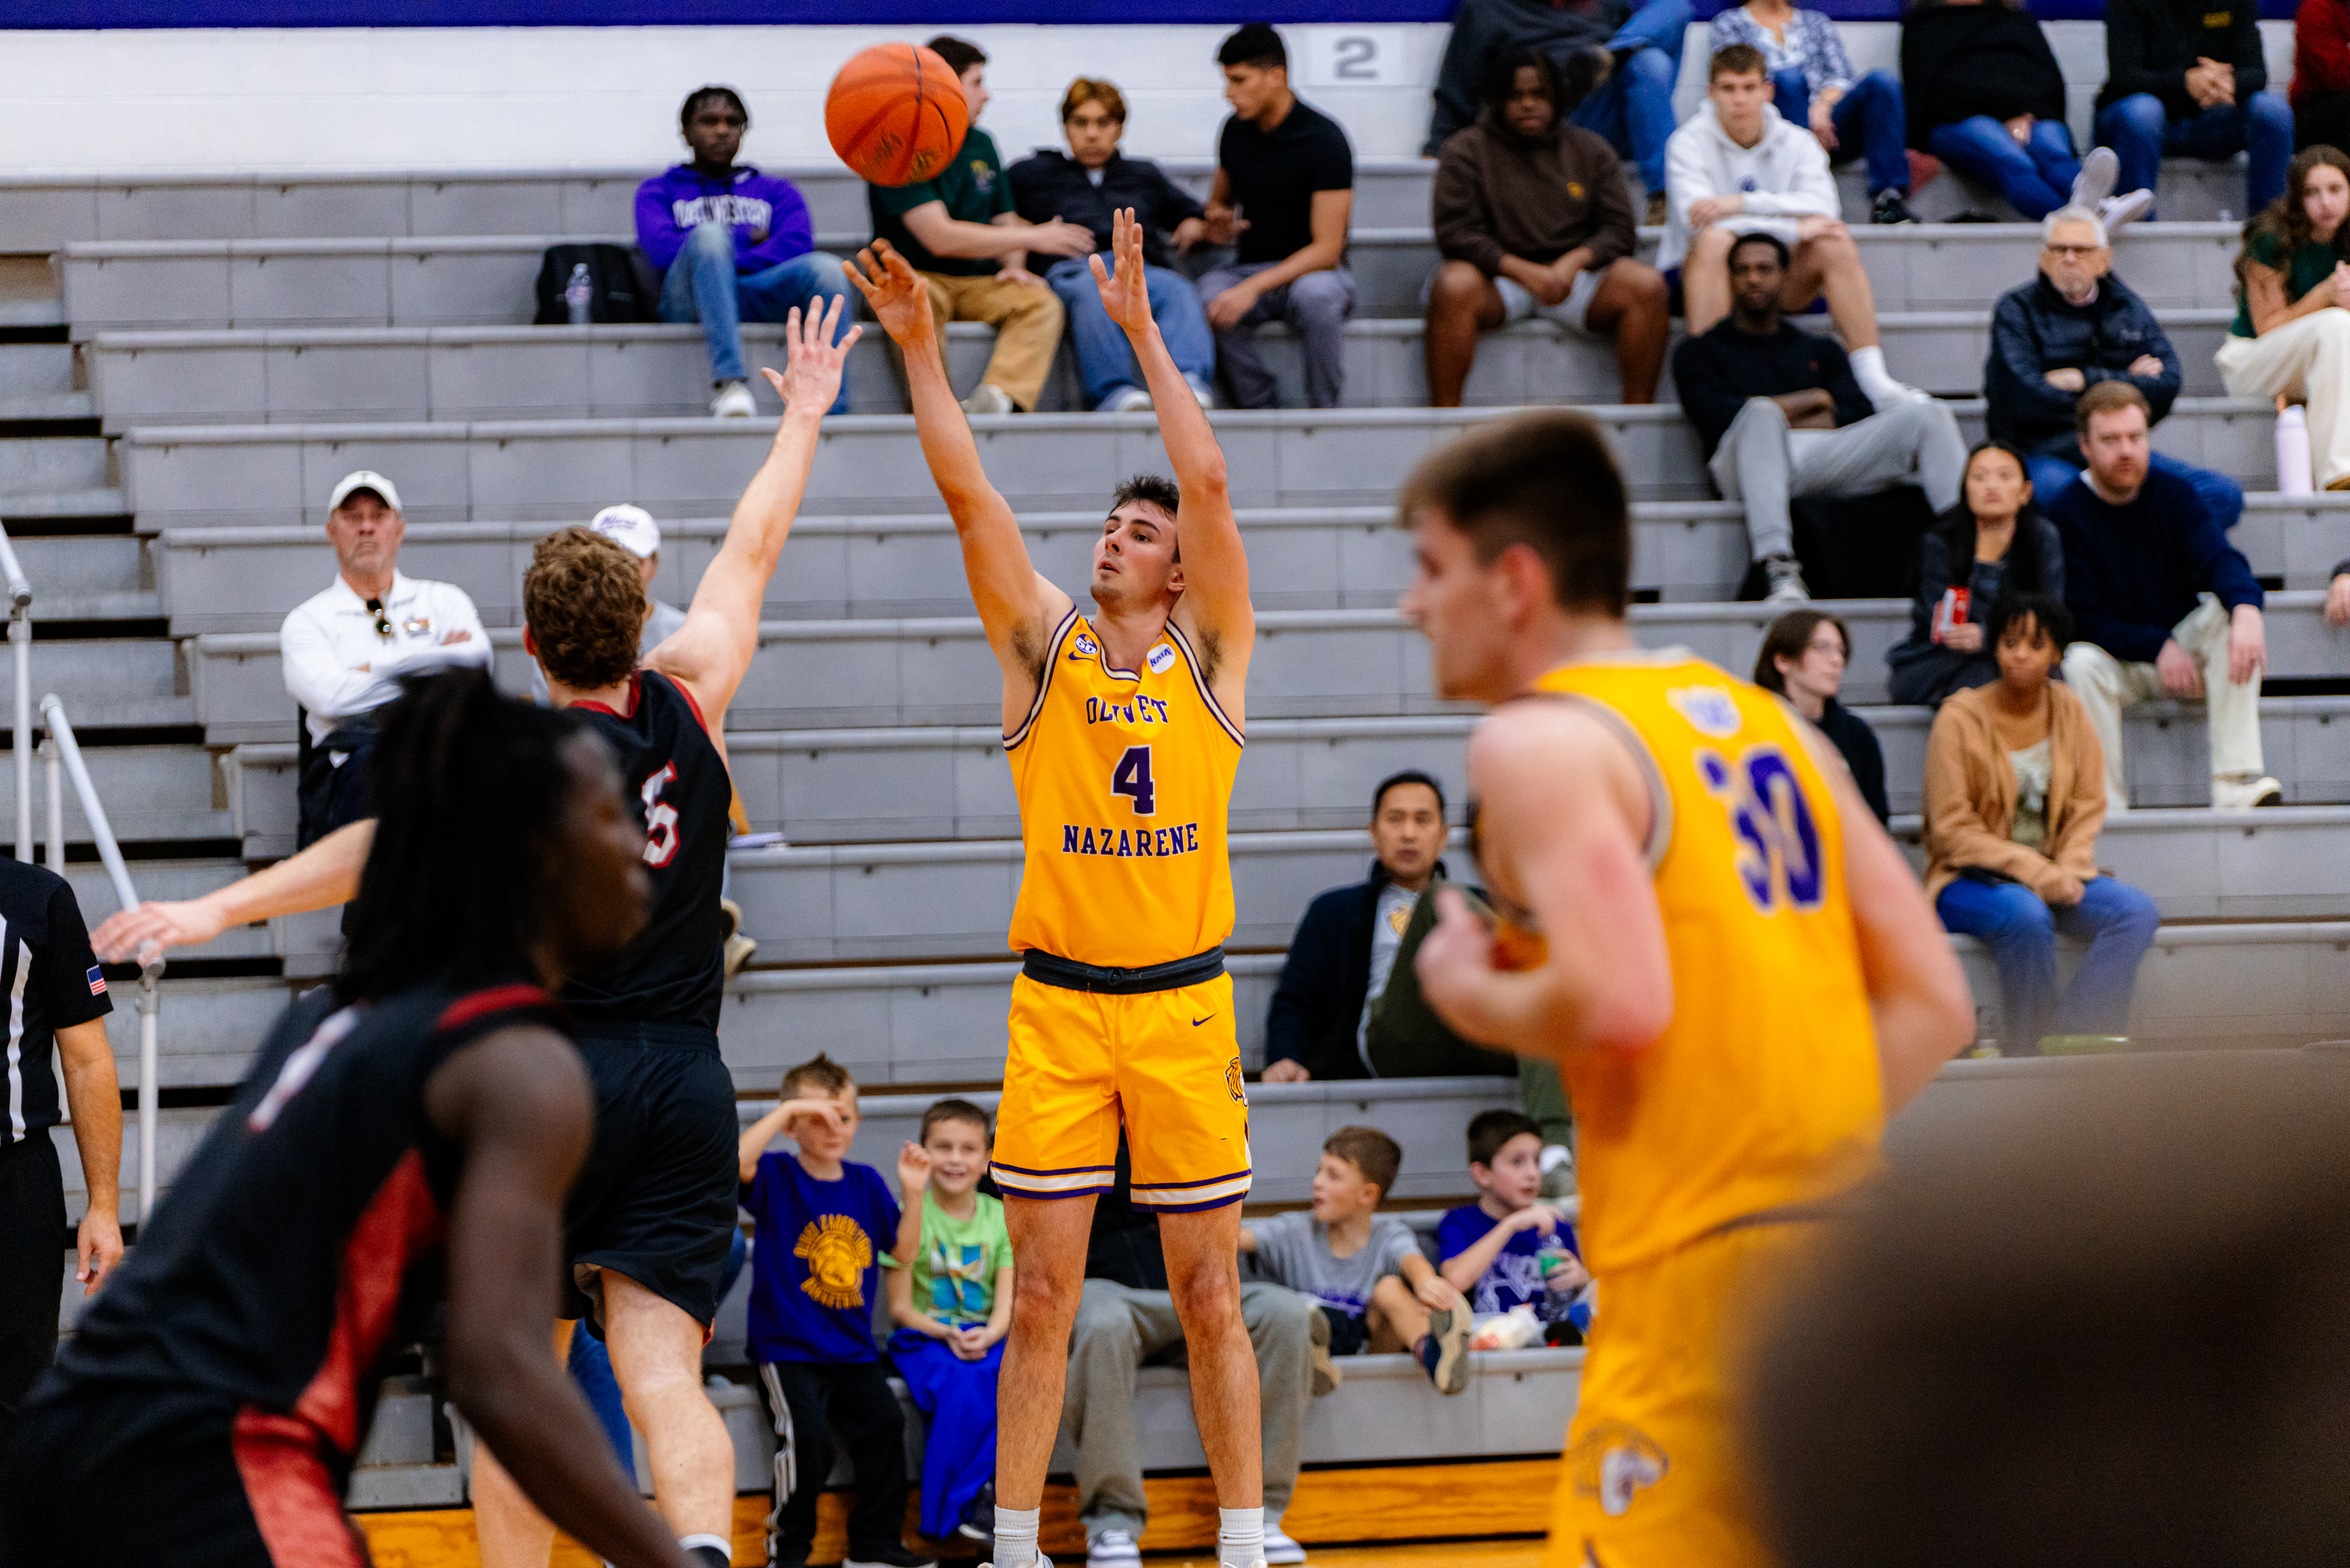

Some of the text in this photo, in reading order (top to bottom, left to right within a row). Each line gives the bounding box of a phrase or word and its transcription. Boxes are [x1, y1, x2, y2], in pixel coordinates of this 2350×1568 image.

[1335, 36, 1378, 80] 2
[1150, 647, 1173, 667] NAIA
[1085, 694, 1169, 725] OLIVET
[1111, 744, 1156, 817] 4
[1062, 822, 1199, 857] NAZARENE
